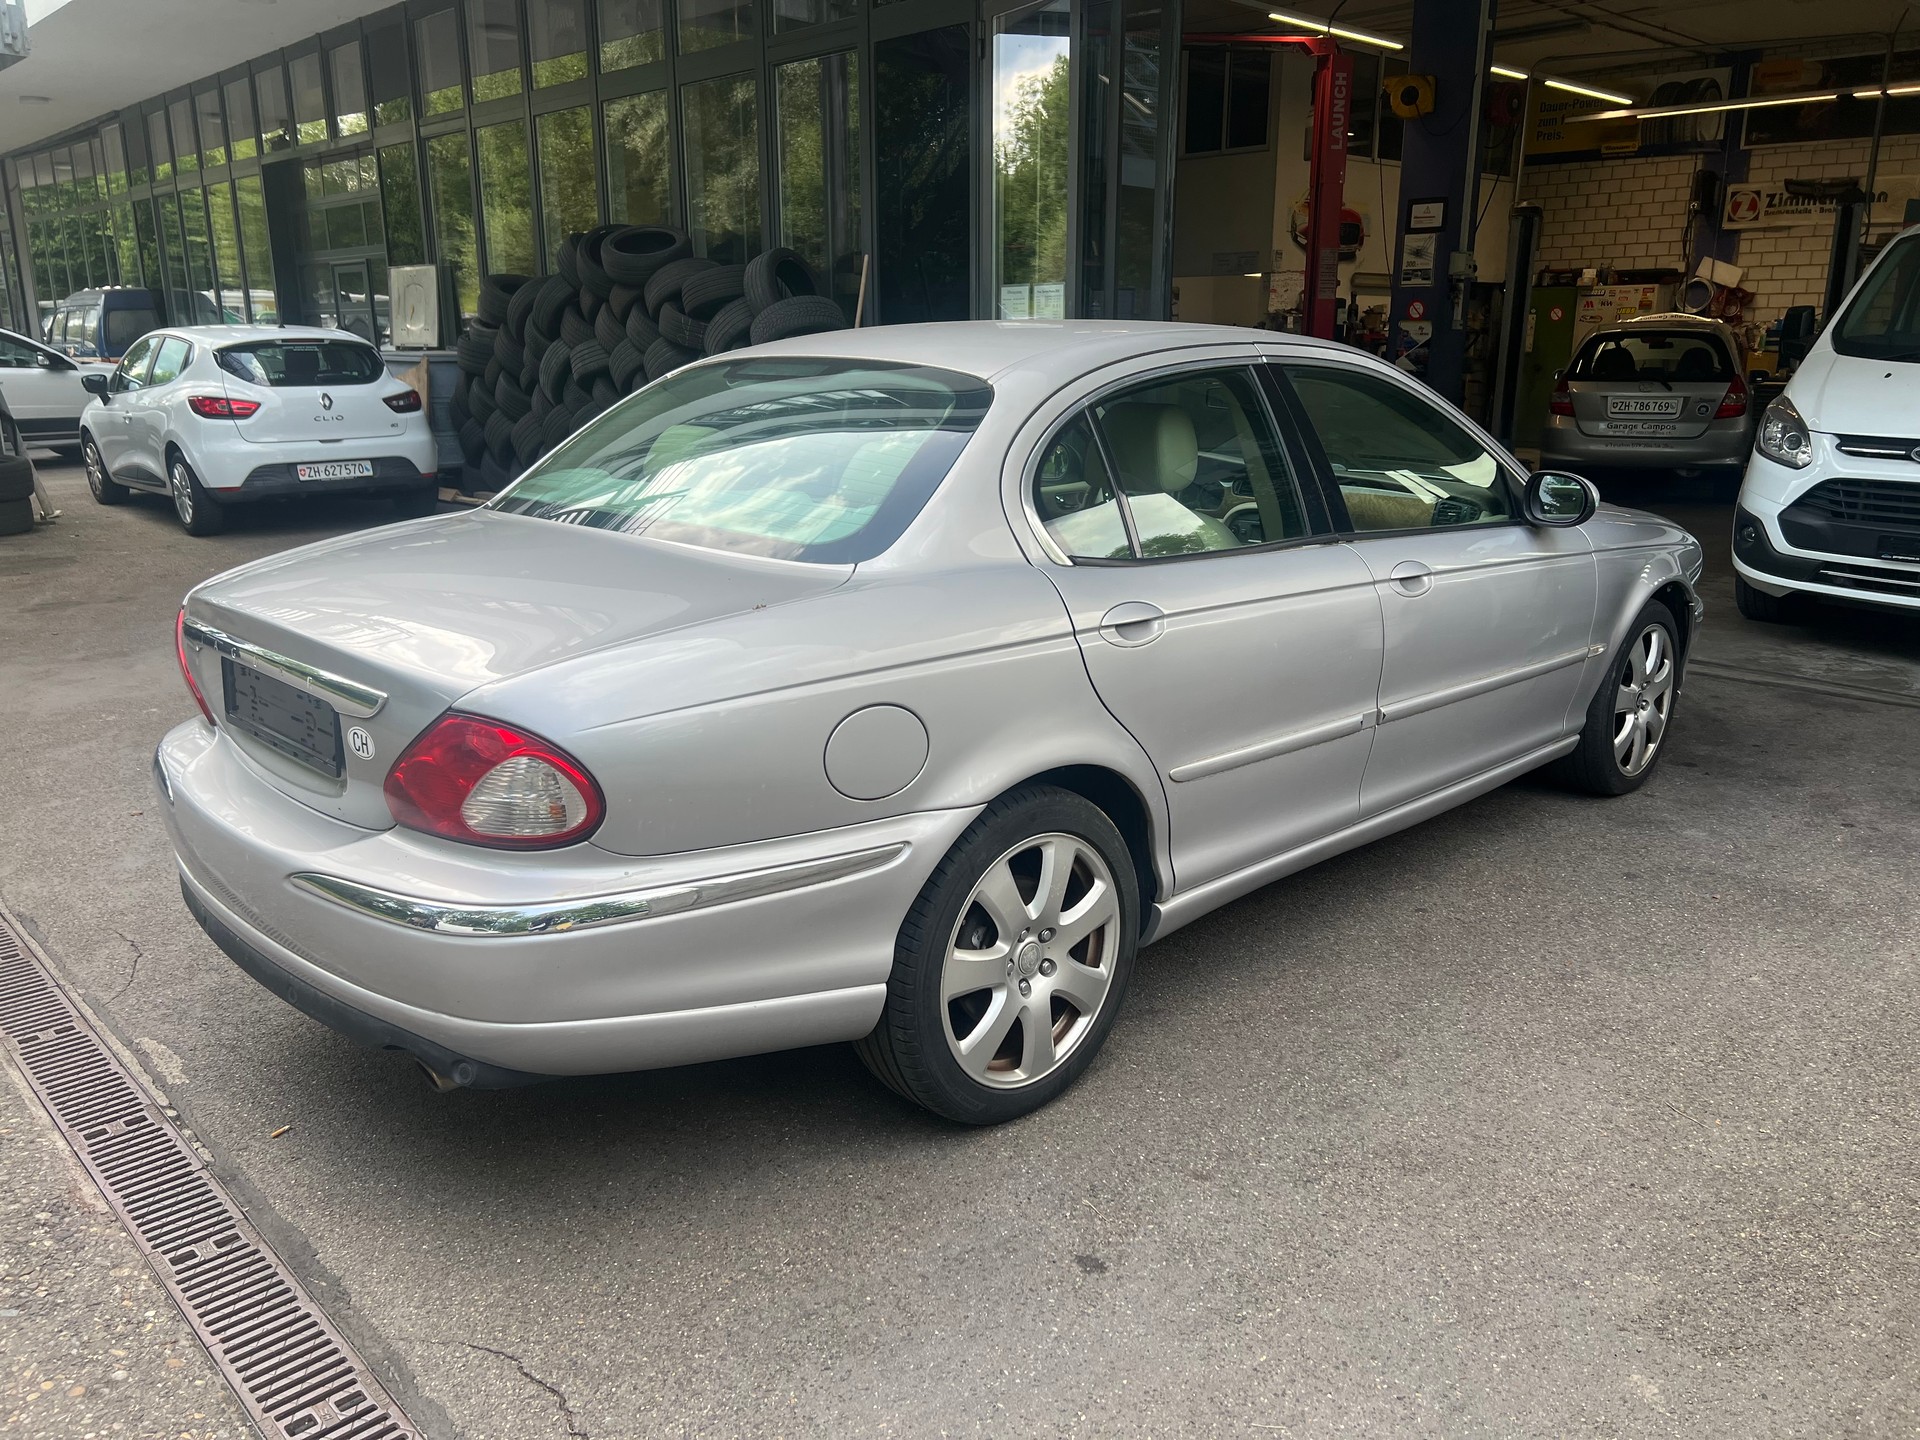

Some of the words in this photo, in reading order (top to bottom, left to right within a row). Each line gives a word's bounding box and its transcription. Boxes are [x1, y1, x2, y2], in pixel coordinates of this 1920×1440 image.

[1331, 72, 1347, 150] LAUNCH
[1540, 98, 1604, 113] Dauer-Power
[1537, 116, 1558, 127] zum
[1536, 129, 1565, 141] Preis.
[313, 414, 345, 422] CLIO
[1607, 422, 1638, 431] Garage
[1641, 422, 1677, 431] Campos
[352, 731, 370, 755] CH
